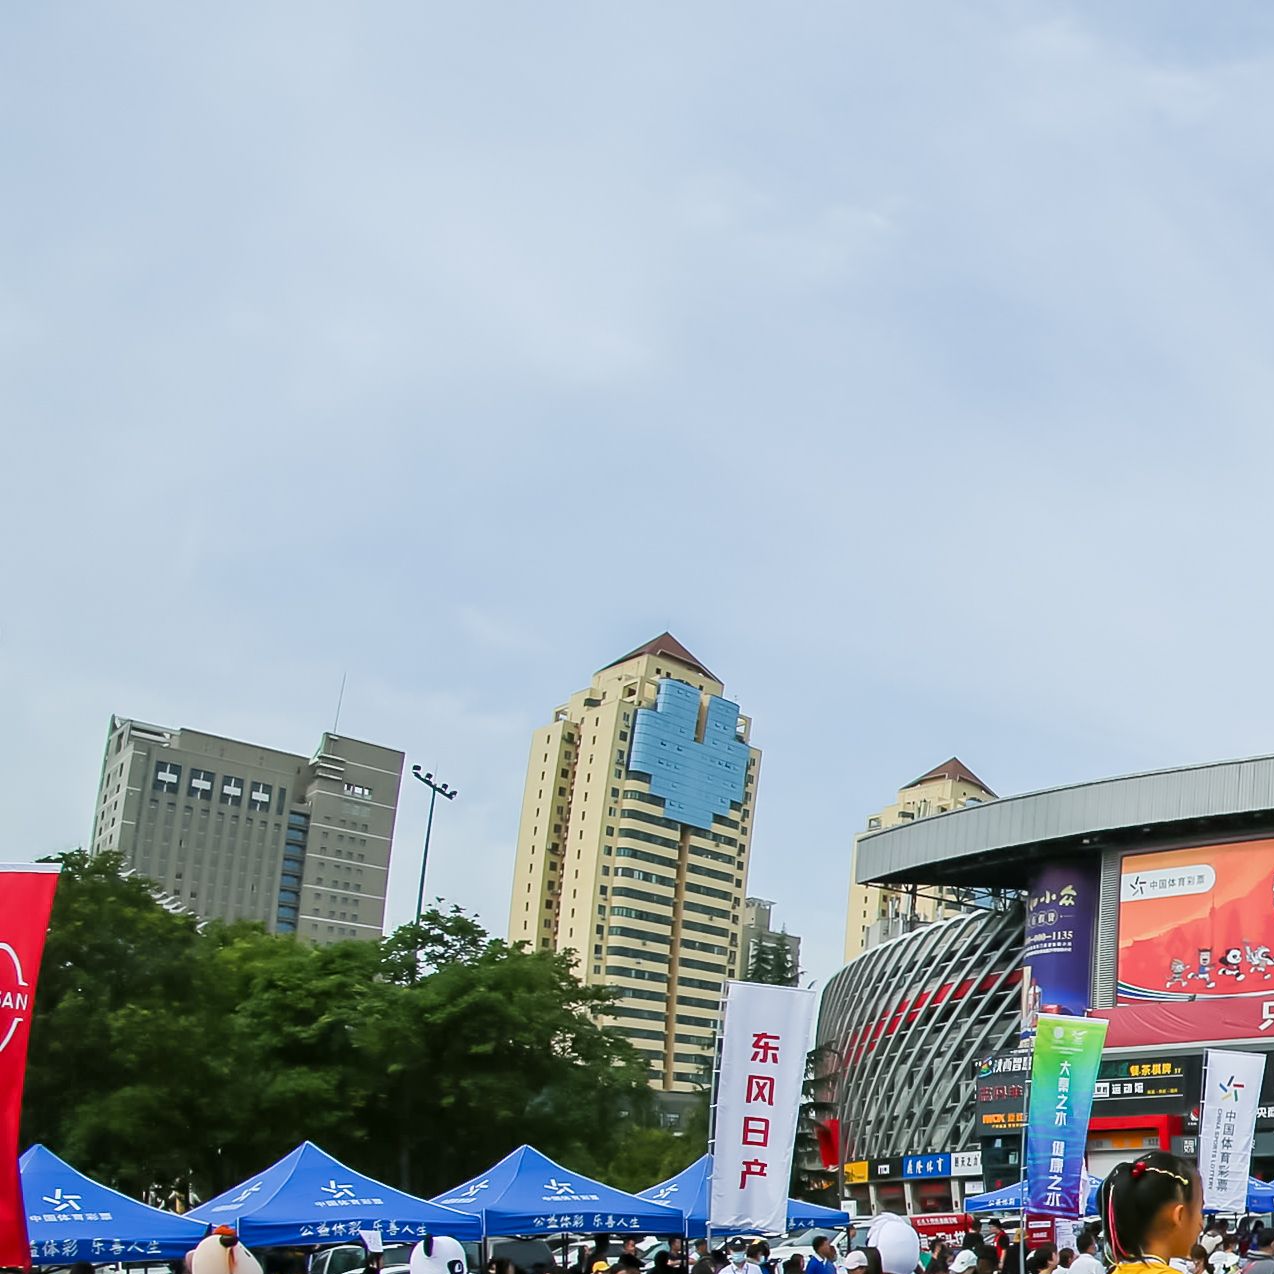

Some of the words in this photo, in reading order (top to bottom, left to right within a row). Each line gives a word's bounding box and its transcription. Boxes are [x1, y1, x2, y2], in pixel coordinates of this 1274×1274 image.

[1149, 874, 1206, 891] 中国体育彩票
[739, 1031, 781, 1190] 东风日产
[1216, 1109, 1237, 1192] 中国体育彩票
[1045, 1140, 1066, 1207] 健康之水
[29, 1212, 113, 1223] 中国体育彩票
[533, 1213, 584, 1229] 公益体彩
[592, 1213, 641, 1229] 乐善人生
[300, 1220, 362, 1237] 公益体彩
[372, 1219, 428, 1236] 乐善人生
[29, 1239, 79, 1258] 益体彩
[90, 1237, 162, 1256] 乐善人生
